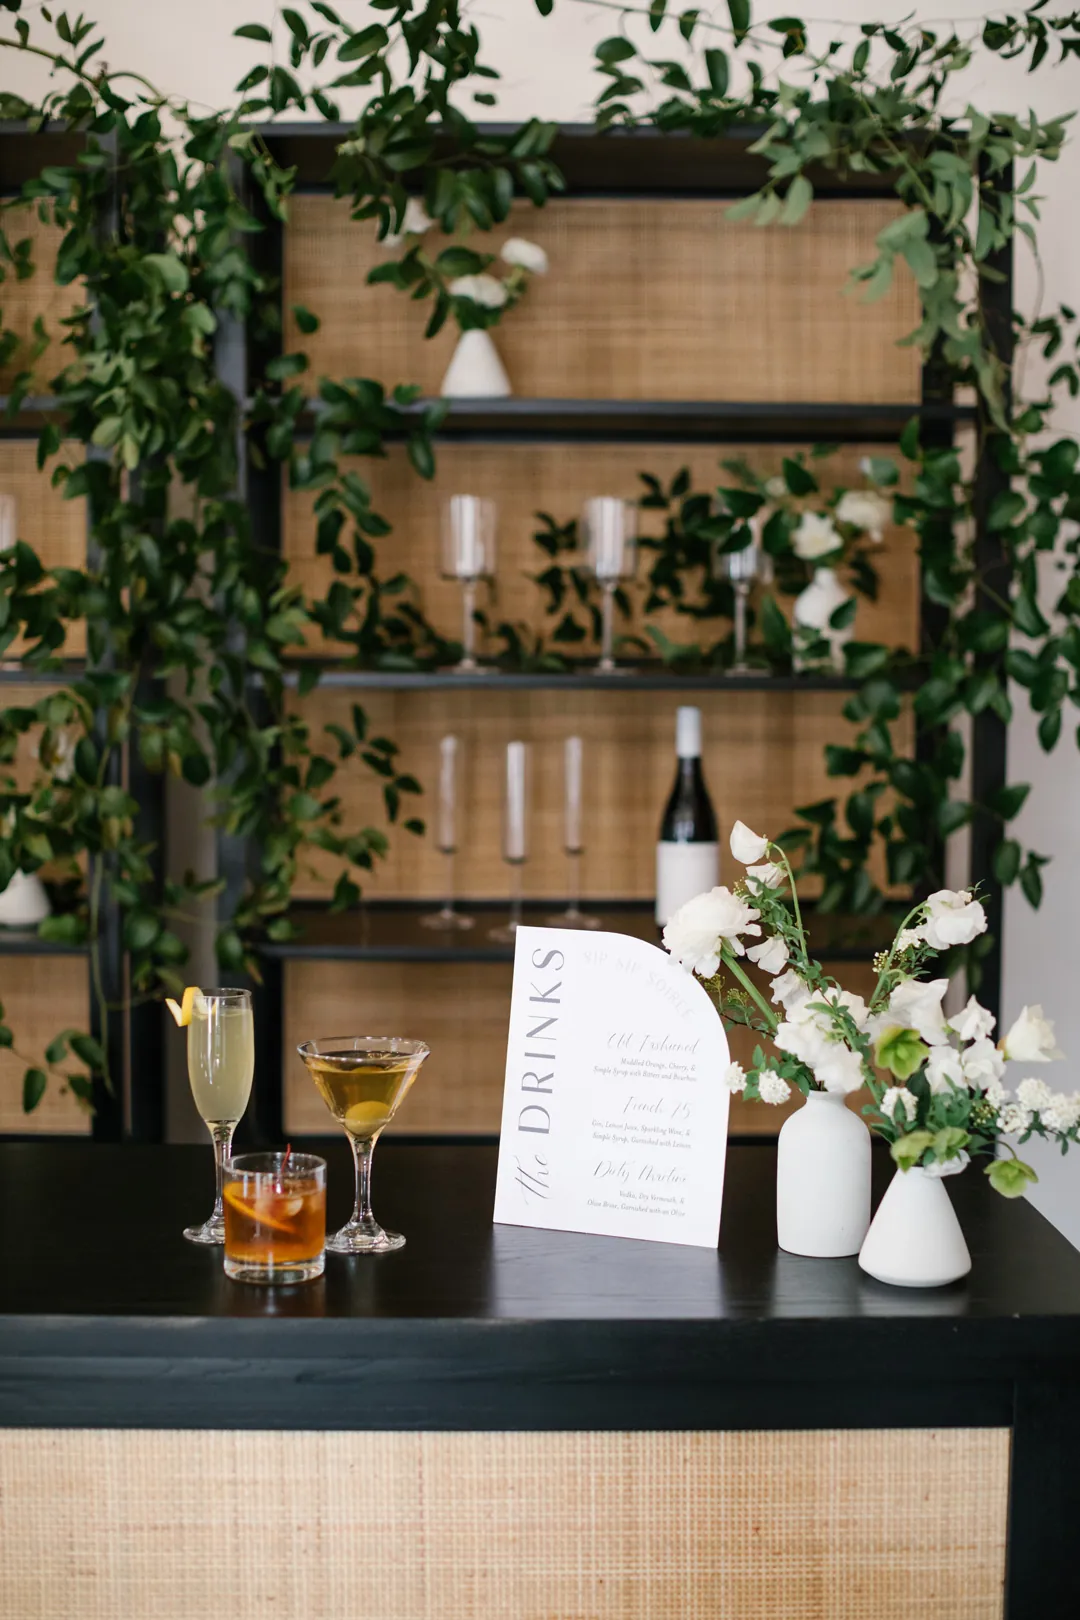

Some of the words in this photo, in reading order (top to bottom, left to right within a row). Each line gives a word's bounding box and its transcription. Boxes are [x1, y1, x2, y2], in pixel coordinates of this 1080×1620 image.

[518, 948, 565, 1134] DRINKS
[607, 1032, 634, 1049] Old
[639, 1034, 700, 1054] Fashioned
[593, 1065, 611, 1075] Simple
[613, 1066, 629, 1077] Syrup
[629, 1068, 642, 1077] with
[642, 1070, 660, 1079] Bitters
[661, 1072, 672, 1080] and
[673, 1074, 697, 1083] Bourbon
[621, 1057, 645, 1067] Muddled
[645, 1060, 667, 1070] Orange,
[668, 1062, 689, 1072] Cherry,
[623, 1096, 664, 1114] French
[671, 1100, 693, 1120] 75
[591, 1118, 604, 1128] Gin,
[605, 1120, 624, 1129] Lemon
[624, 1122, 639, 1132] Juice,
[640, 1124, 668, 1135] Sparkling
[668, 1127, 684, 1137] Wine,
[592, 1131, 611, 1142] Simple
[612, 1134, 629, 1144] Syrup,
[631, 1136, 659, 1146] Garnished
[659, 1139, 671, 1147] with
[672, 1140, 692, 1149] Lemon
[514, 1153, 550, 1205] the
[593, 1159, 634, 1184] Dirty
[638, 1163, 686, 1183] Martini
[619, 1190, 637, 1200] Vodka,
[638, 1192, 649, 1202] Dry
[650, 1194, 677, 1204] Vermouth,
[587, 1198, 602, 1207] Olive
[602, 1201, 619, 1210] Brine,
[620, 1203, 648, 1213] Garnished
[648, 1207, 661, 1215] with
[670, 1209, 686, 1218] Olive
